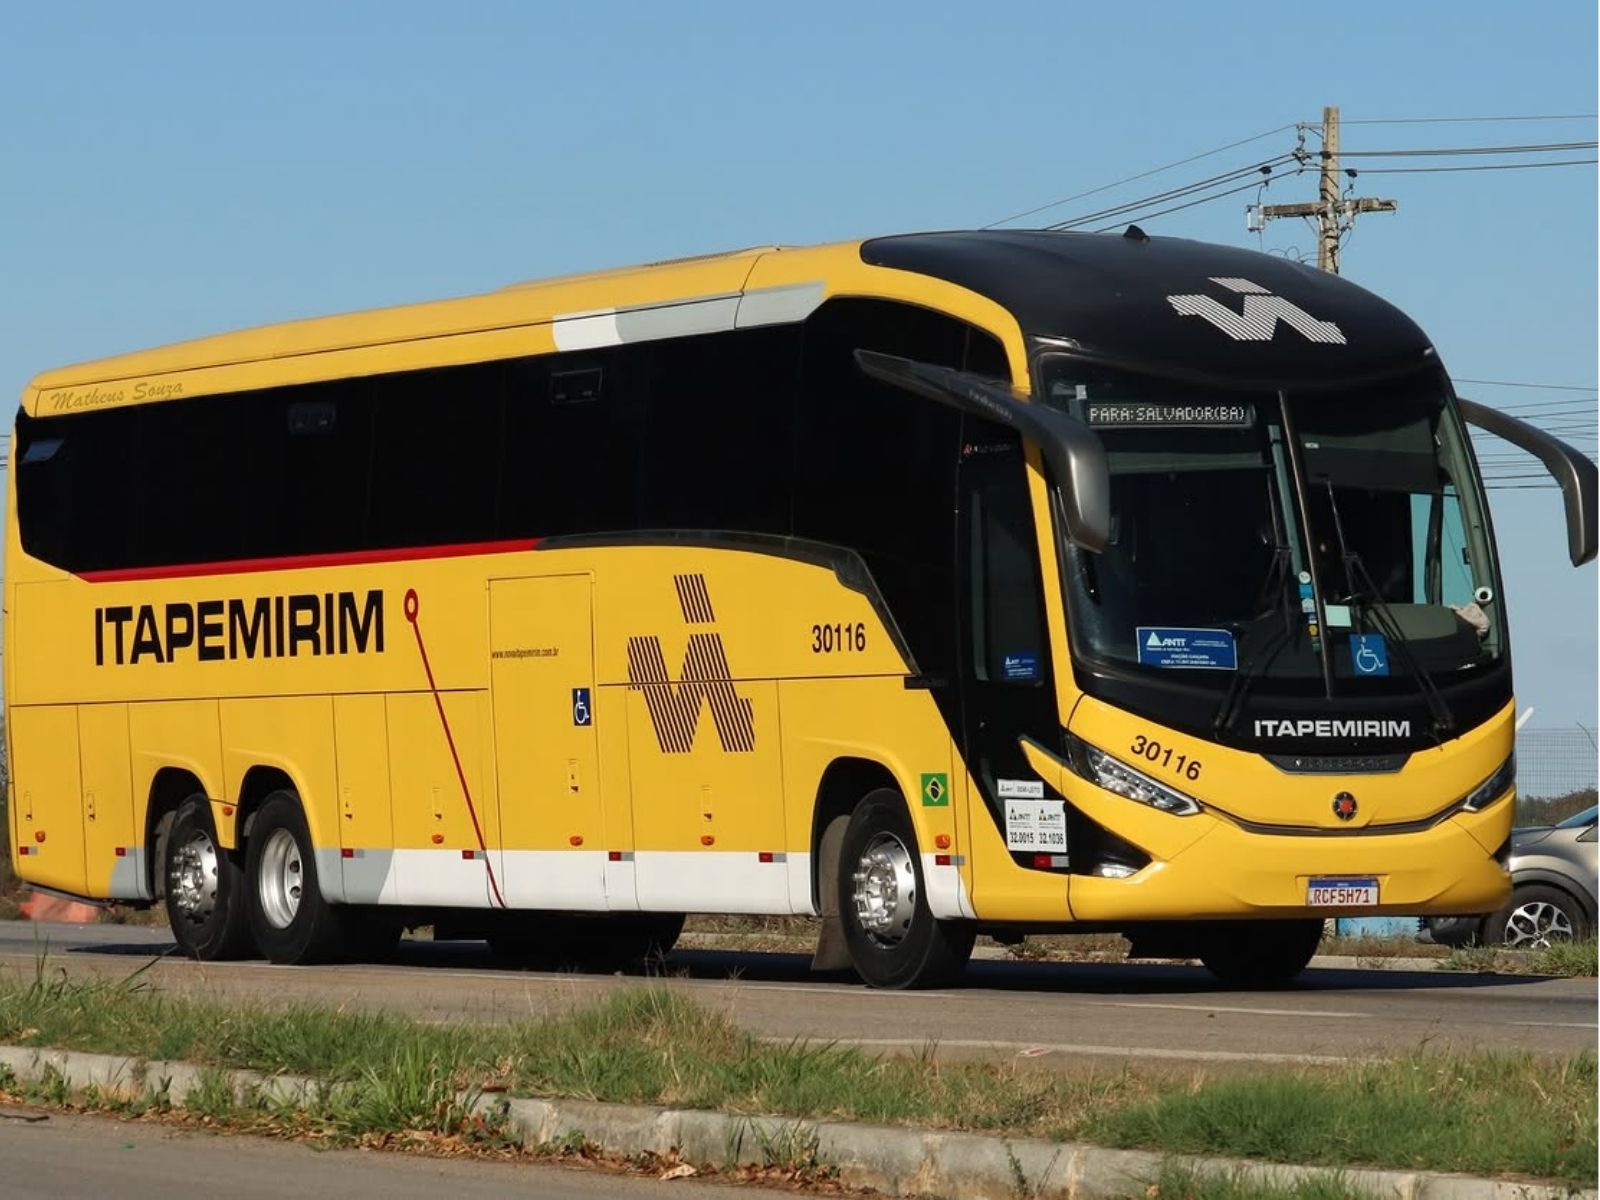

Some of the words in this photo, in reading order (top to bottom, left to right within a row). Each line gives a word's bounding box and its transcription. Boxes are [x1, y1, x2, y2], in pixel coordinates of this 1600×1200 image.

[95, 589, 384, 666] ITAPEMIRIM
[811, 622, 866, 653] 30116
[1254, 719, 1411, 738] ITAPEMIRIM
[1130, 734, 1202, 781] 30116
[1313, 889, 1370, 904] RCF5H71
